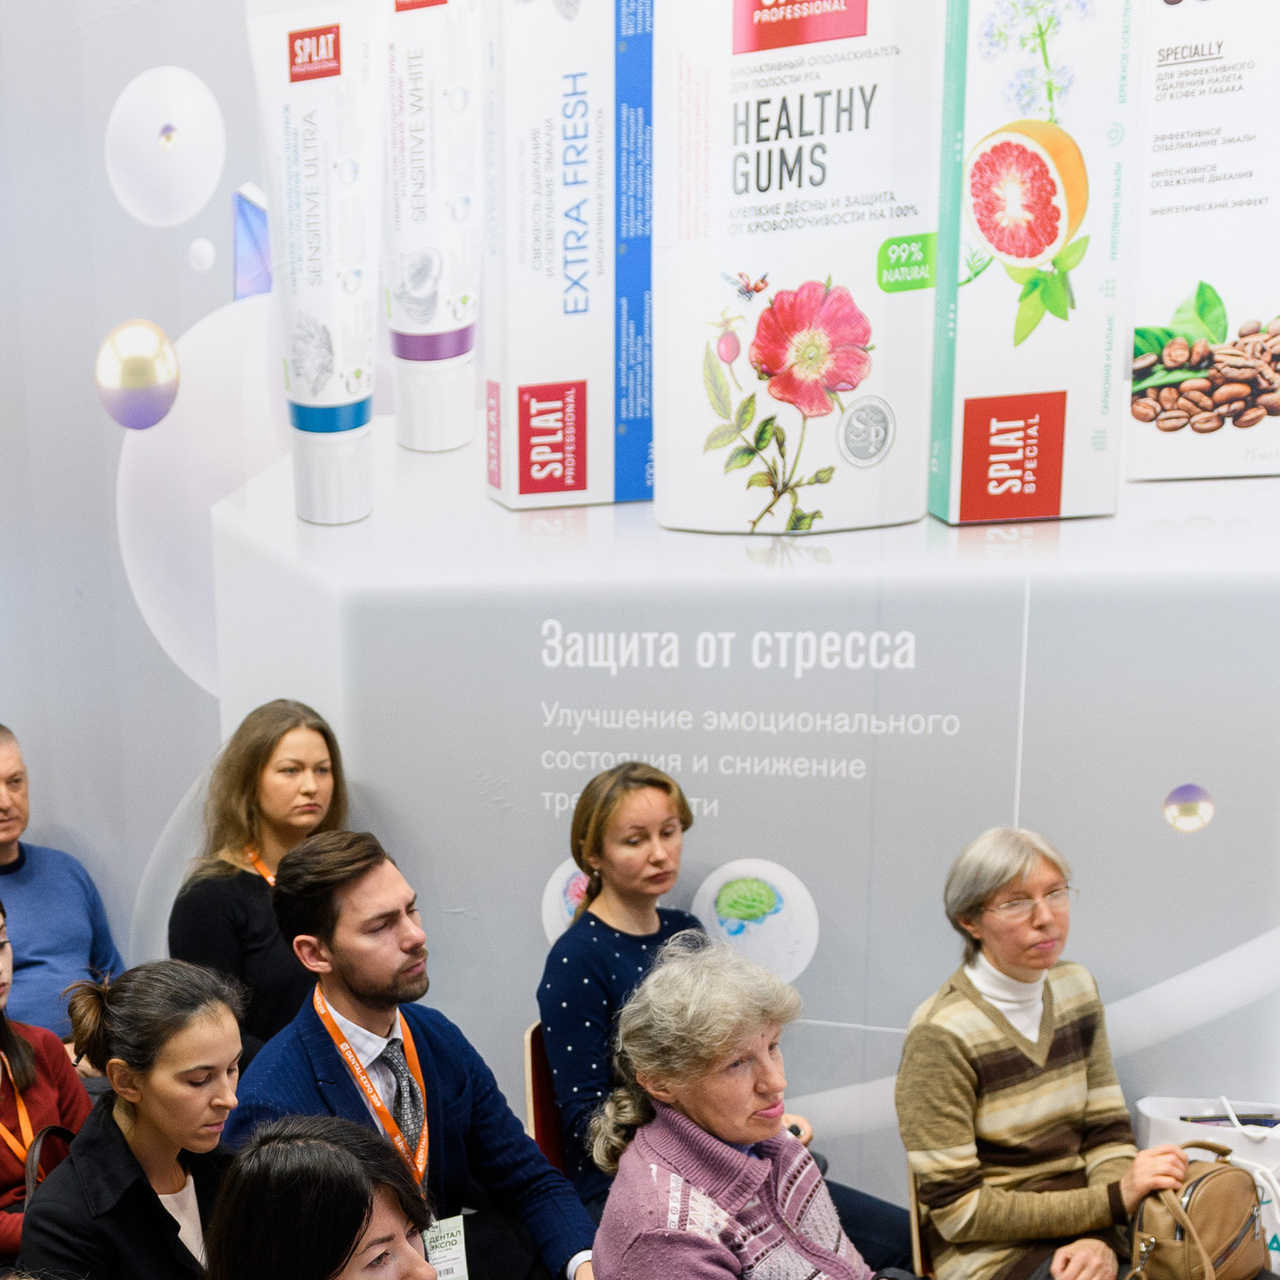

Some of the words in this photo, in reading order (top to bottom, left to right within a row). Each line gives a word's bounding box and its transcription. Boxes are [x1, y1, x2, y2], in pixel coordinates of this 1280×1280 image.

[752, 0, 848, 25] PROFESSIONAL
[294, 33, 336, 65] SPLAT
[407, 48, 424, 116] WHITE
[1157, 40, 1224, 62] SPECIALLY
[302, 109, 319, 178] ULTRA
[561, 71, 589, 187] FRESH
[732, 83, 879, 147] HEALTHY
[409, 121, 427, 223] SENSITIVE
[731, 144, 829, 196] GUMS
[306, 185, 322, 287] SENSITIVE
[562, 198, 590, 316] EXTRA
[886, 241, 925, 264] 99%
[882, 264, 931, 284] NATURAL
[529, 397, 564, 480] SPLAT
[563, 387, 576, 486] PROFESSIONAL
[987, 416, 1026, 496] SPLAT
[1022, 413, 1041, 494] SPECIAL
[540, 618, 680, 677] Защита
[695, 629, 736, 669] от
[751, 628, 917, 679] стресса
[540, 700, 694, 736] Улучшение
[702, 707, 961, 737] эмоционального
[692, 752, 709, 774] и
[719, 751, 867, 780] снижение
